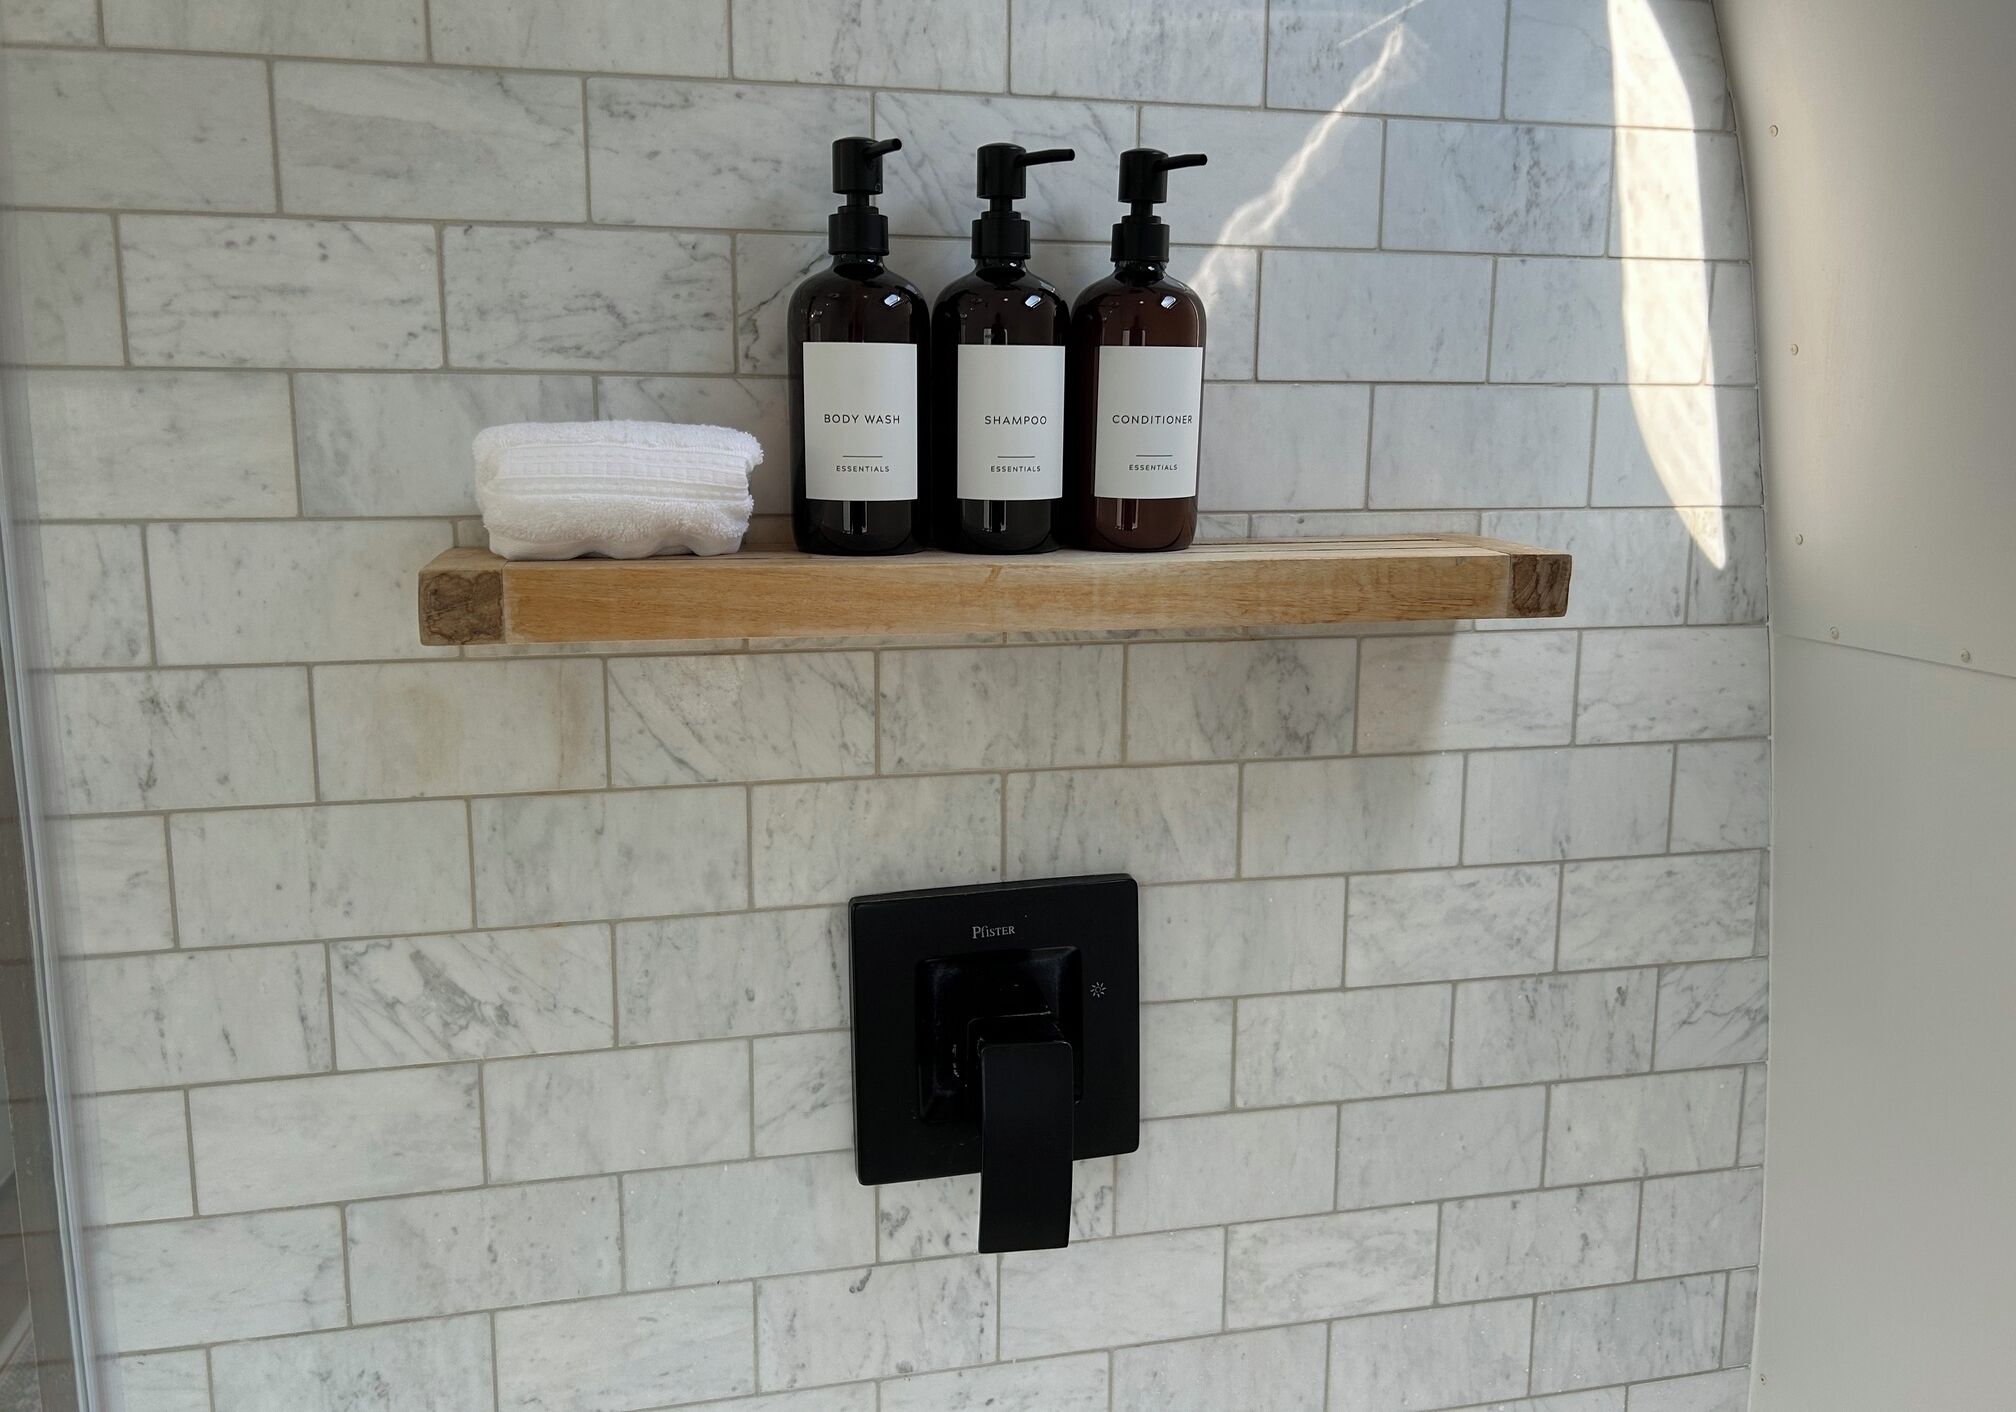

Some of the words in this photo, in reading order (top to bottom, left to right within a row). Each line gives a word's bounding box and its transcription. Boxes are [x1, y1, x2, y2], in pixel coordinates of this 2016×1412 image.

[823, 413, 860, 424] BODY
[863, 414, 900, 425] WASH
[984, 415, 1047, 426] SHAMPOO
[1111, 414, 1193, 425] CONDITIONER
[835, 465, 890, 473] ESSENTIALS
[990, 465, 1041, 473] ESSENTIALS
[1128, 464, 1178, 472] ESSENTIALS
